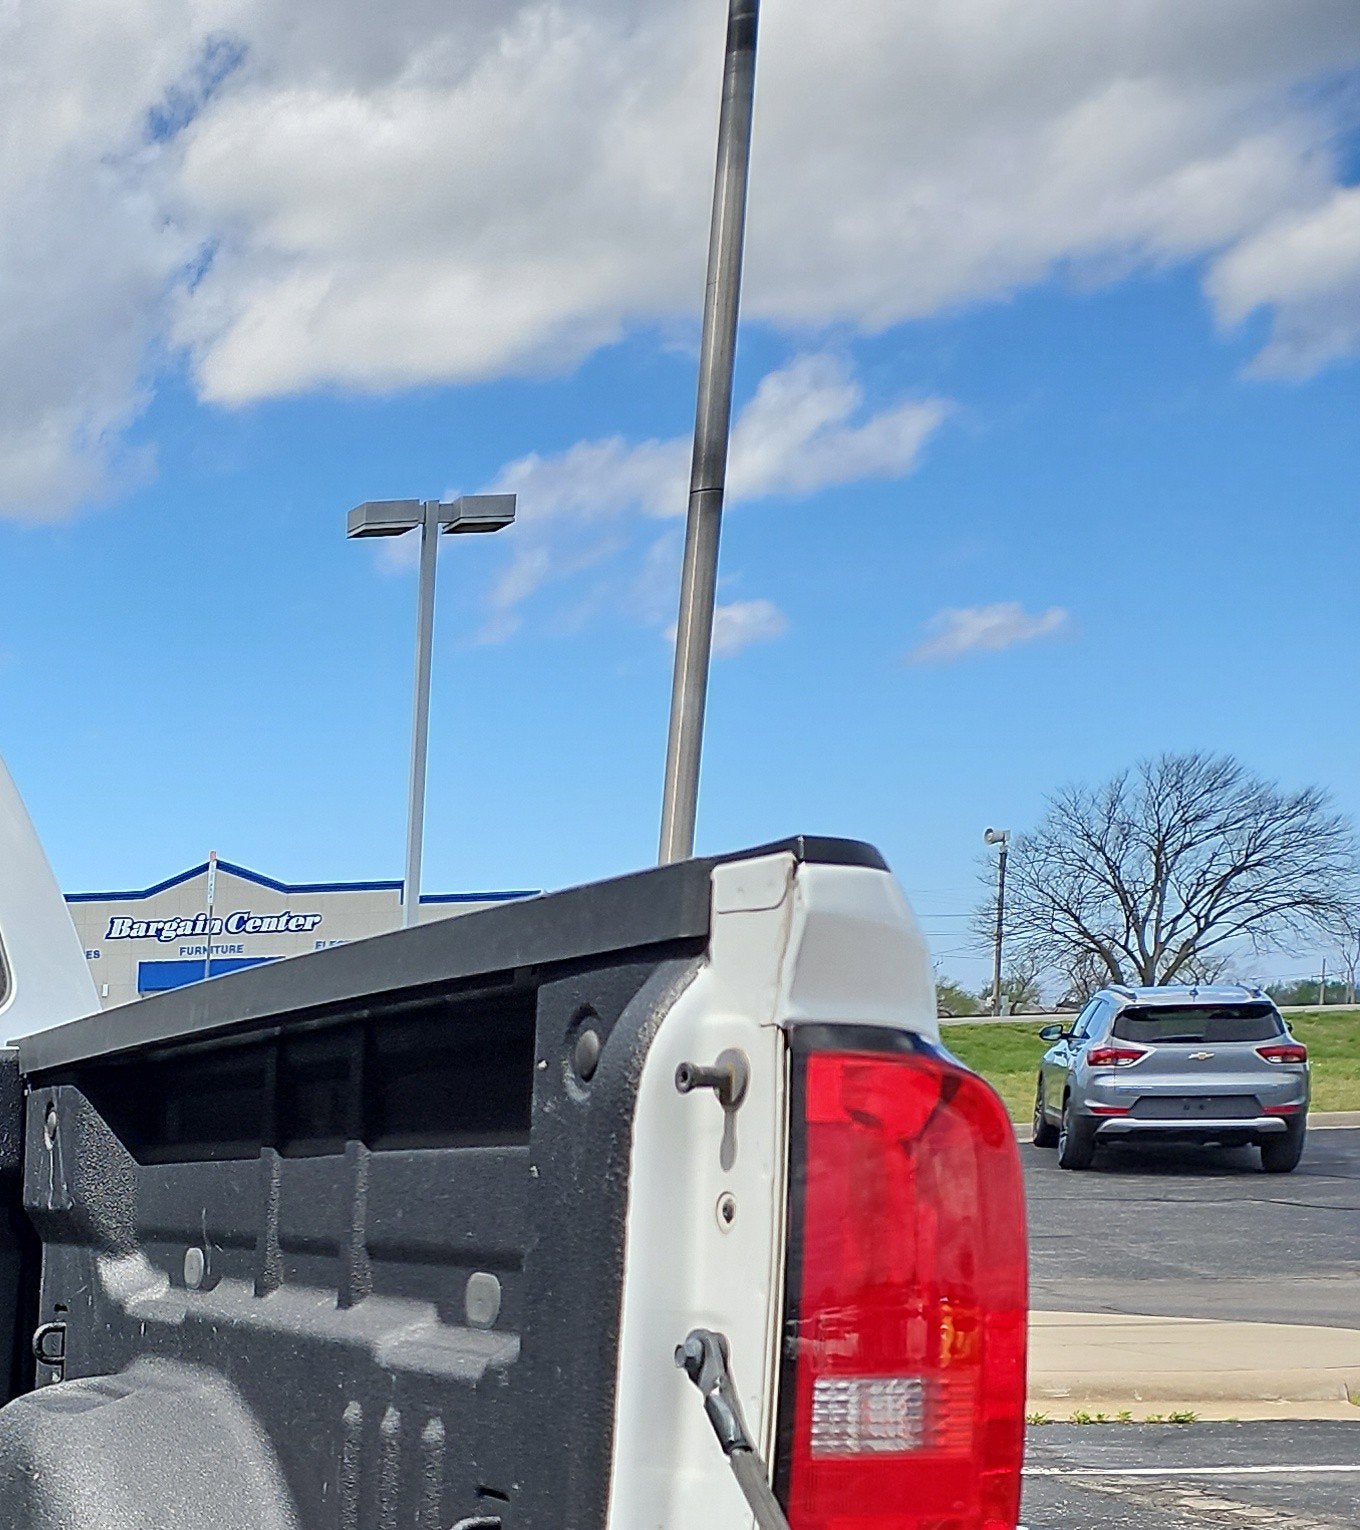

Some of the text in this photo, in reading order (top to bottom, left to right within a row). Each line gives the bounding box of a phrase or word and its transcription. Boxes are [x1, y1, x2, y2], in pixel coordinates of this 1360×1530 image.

[104, 911, 321, 941] Bargain Center
[179, 945, 244, 956] FURNITURE
